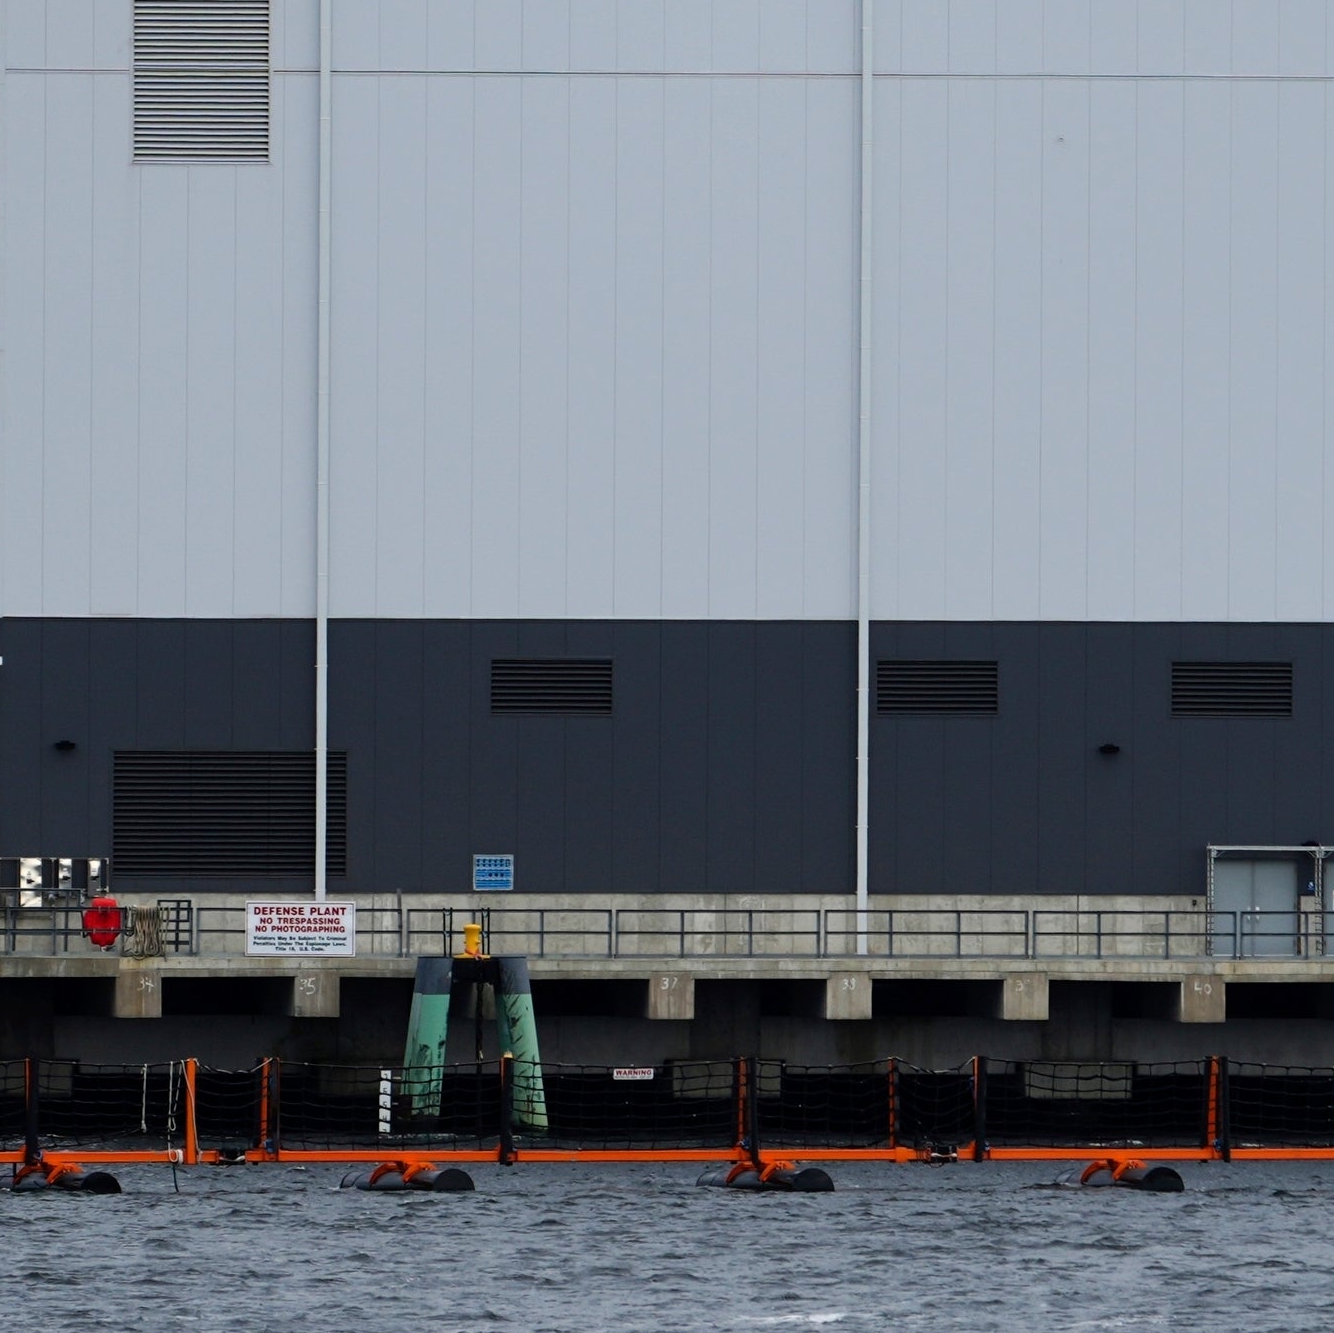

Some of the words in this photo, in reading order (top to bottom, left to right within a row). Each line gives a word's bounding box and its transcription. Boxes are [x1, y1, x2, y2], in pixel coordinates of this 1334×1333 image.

[253, 906, 305, 916] DEFENSE
[310, 907, 347, 916] PLANT
[259, 917, 273, 925] NO
[277, 917, 340, 925] TRESPASSING
[255, 925, 267, 933] NO
[271, 925, 345, 933] PHOTOGRAPHING
[299, 977, 316, 995] 35
